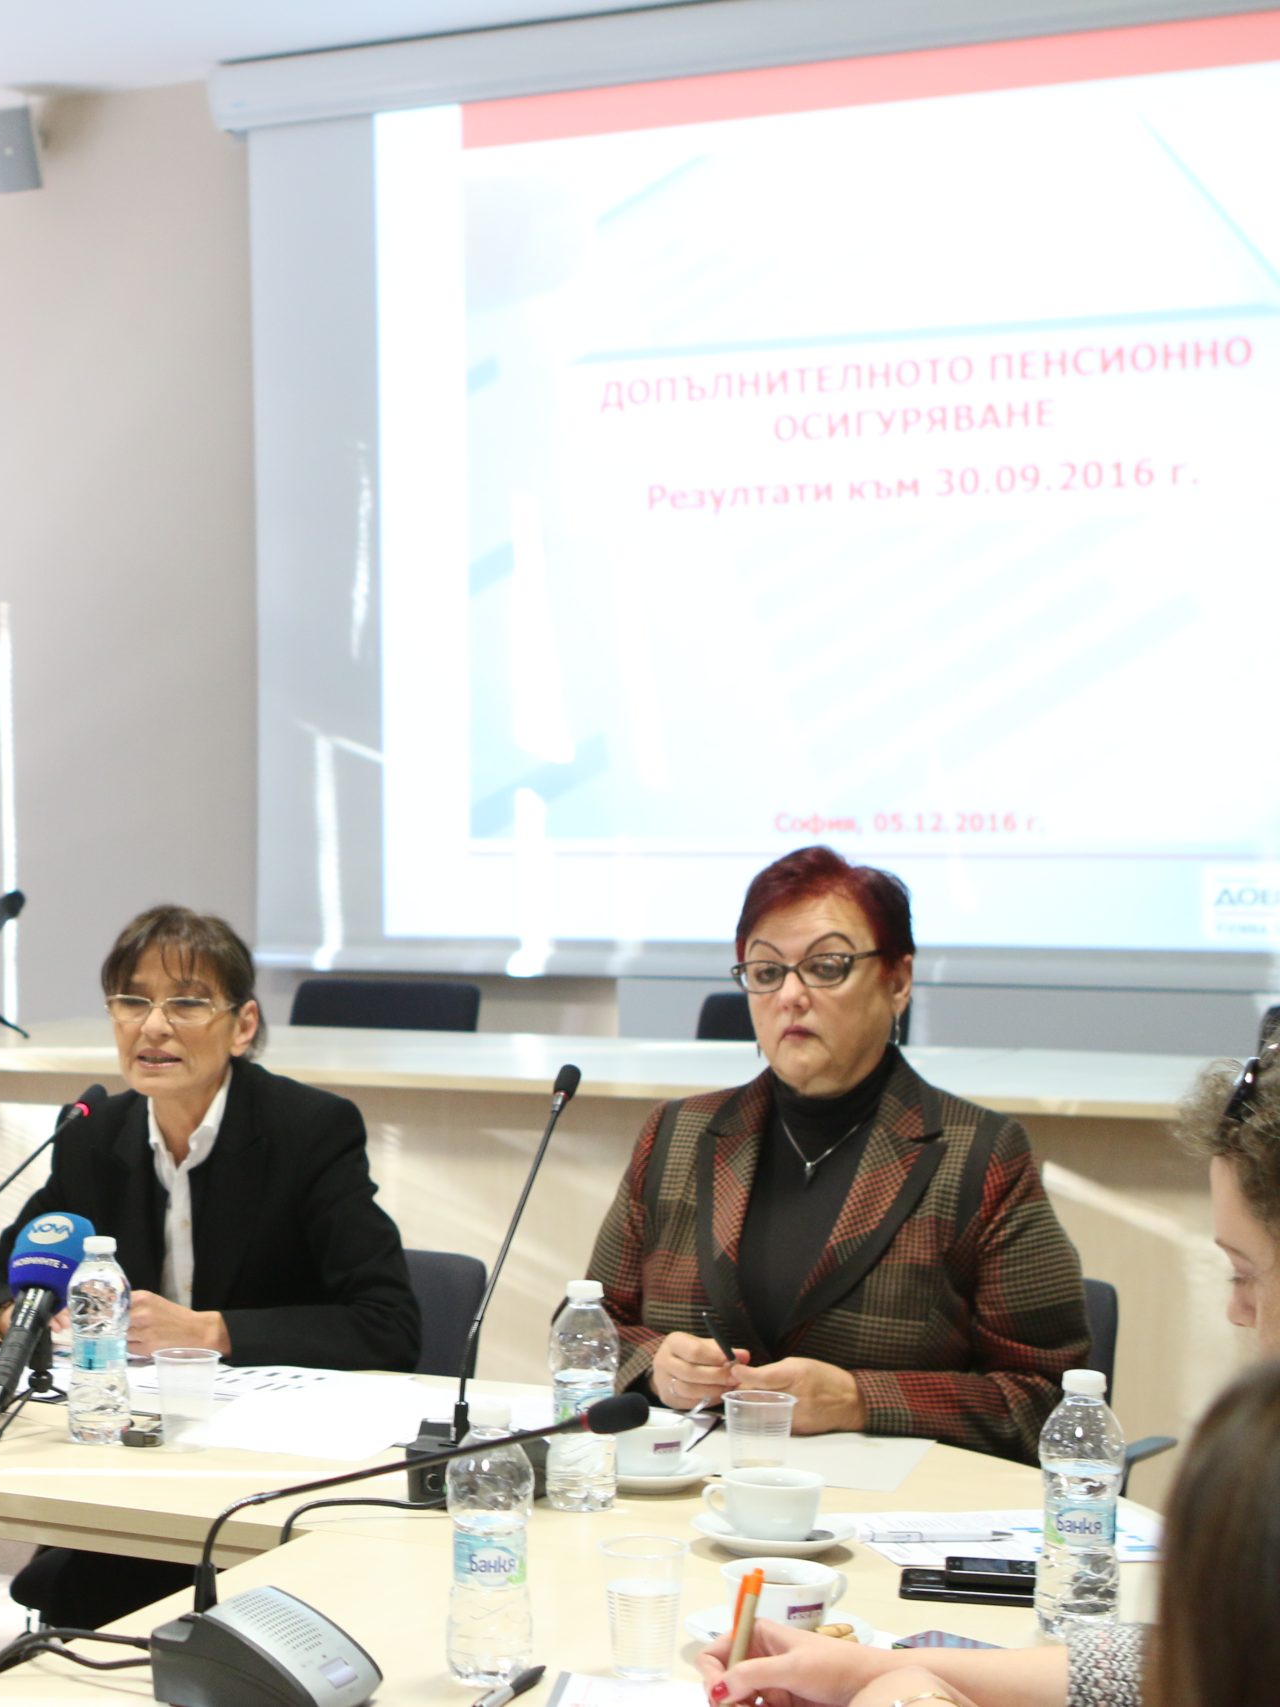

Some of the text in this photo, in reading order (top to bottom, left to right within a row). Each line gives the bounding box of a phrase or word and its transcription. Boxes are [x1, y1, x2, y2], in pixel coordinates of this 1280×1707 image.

[600, 336, 1253, 413] ДОПЪЛНИТЕЛНОТО ПЕНСИОННО
[773, 399, 1054, 441] ОСИГУРЯВАНЕ
[647, 458, 1199, 515] Резултати към 30.09.2016 г.
[873, 813, 1018, 833] 05.12.2016
[1025, 817, 1045, 833] г.
[1056, 1513, 1103, 1535] Банкя
[468, 1553, 516, 1573] Банкя
